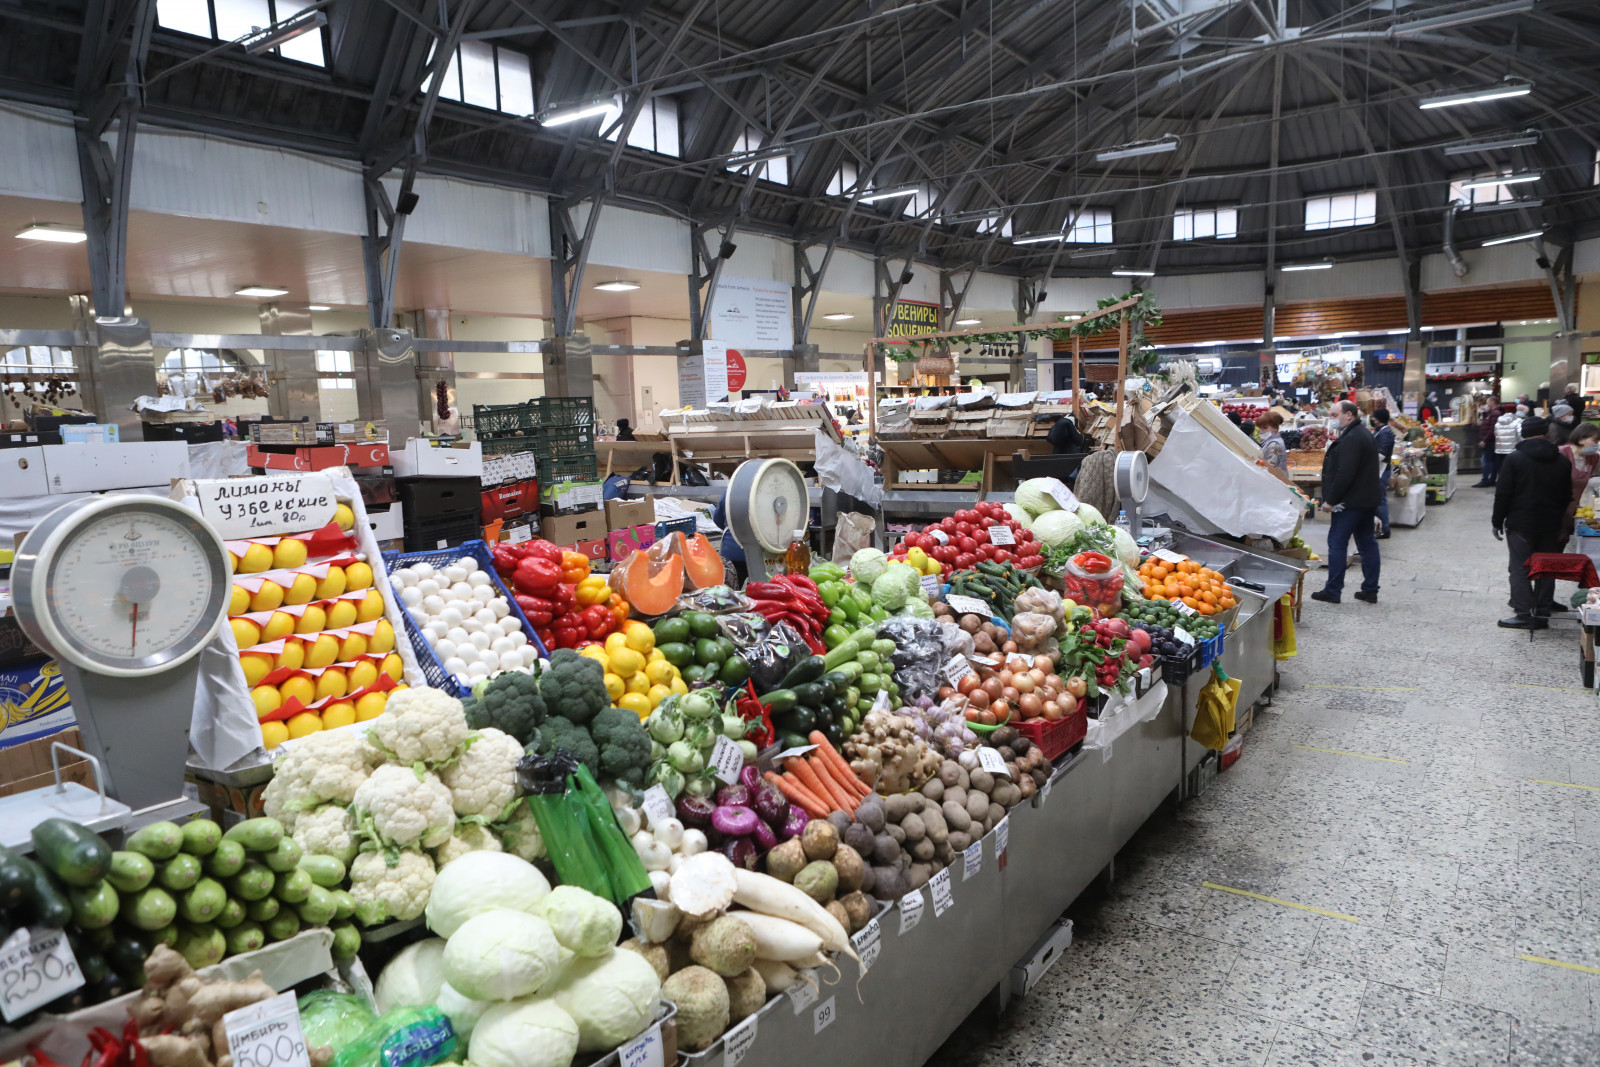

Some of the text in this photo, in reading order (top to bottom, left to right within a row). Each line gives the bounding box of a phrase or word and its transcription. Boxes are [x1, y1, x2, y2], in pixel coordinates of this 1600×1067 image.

[1301, 344, 1340, 358] СПЕЦИИ
[498, 489, 522, 500] Romaine
[818, 1006, 831, 1026] 99
